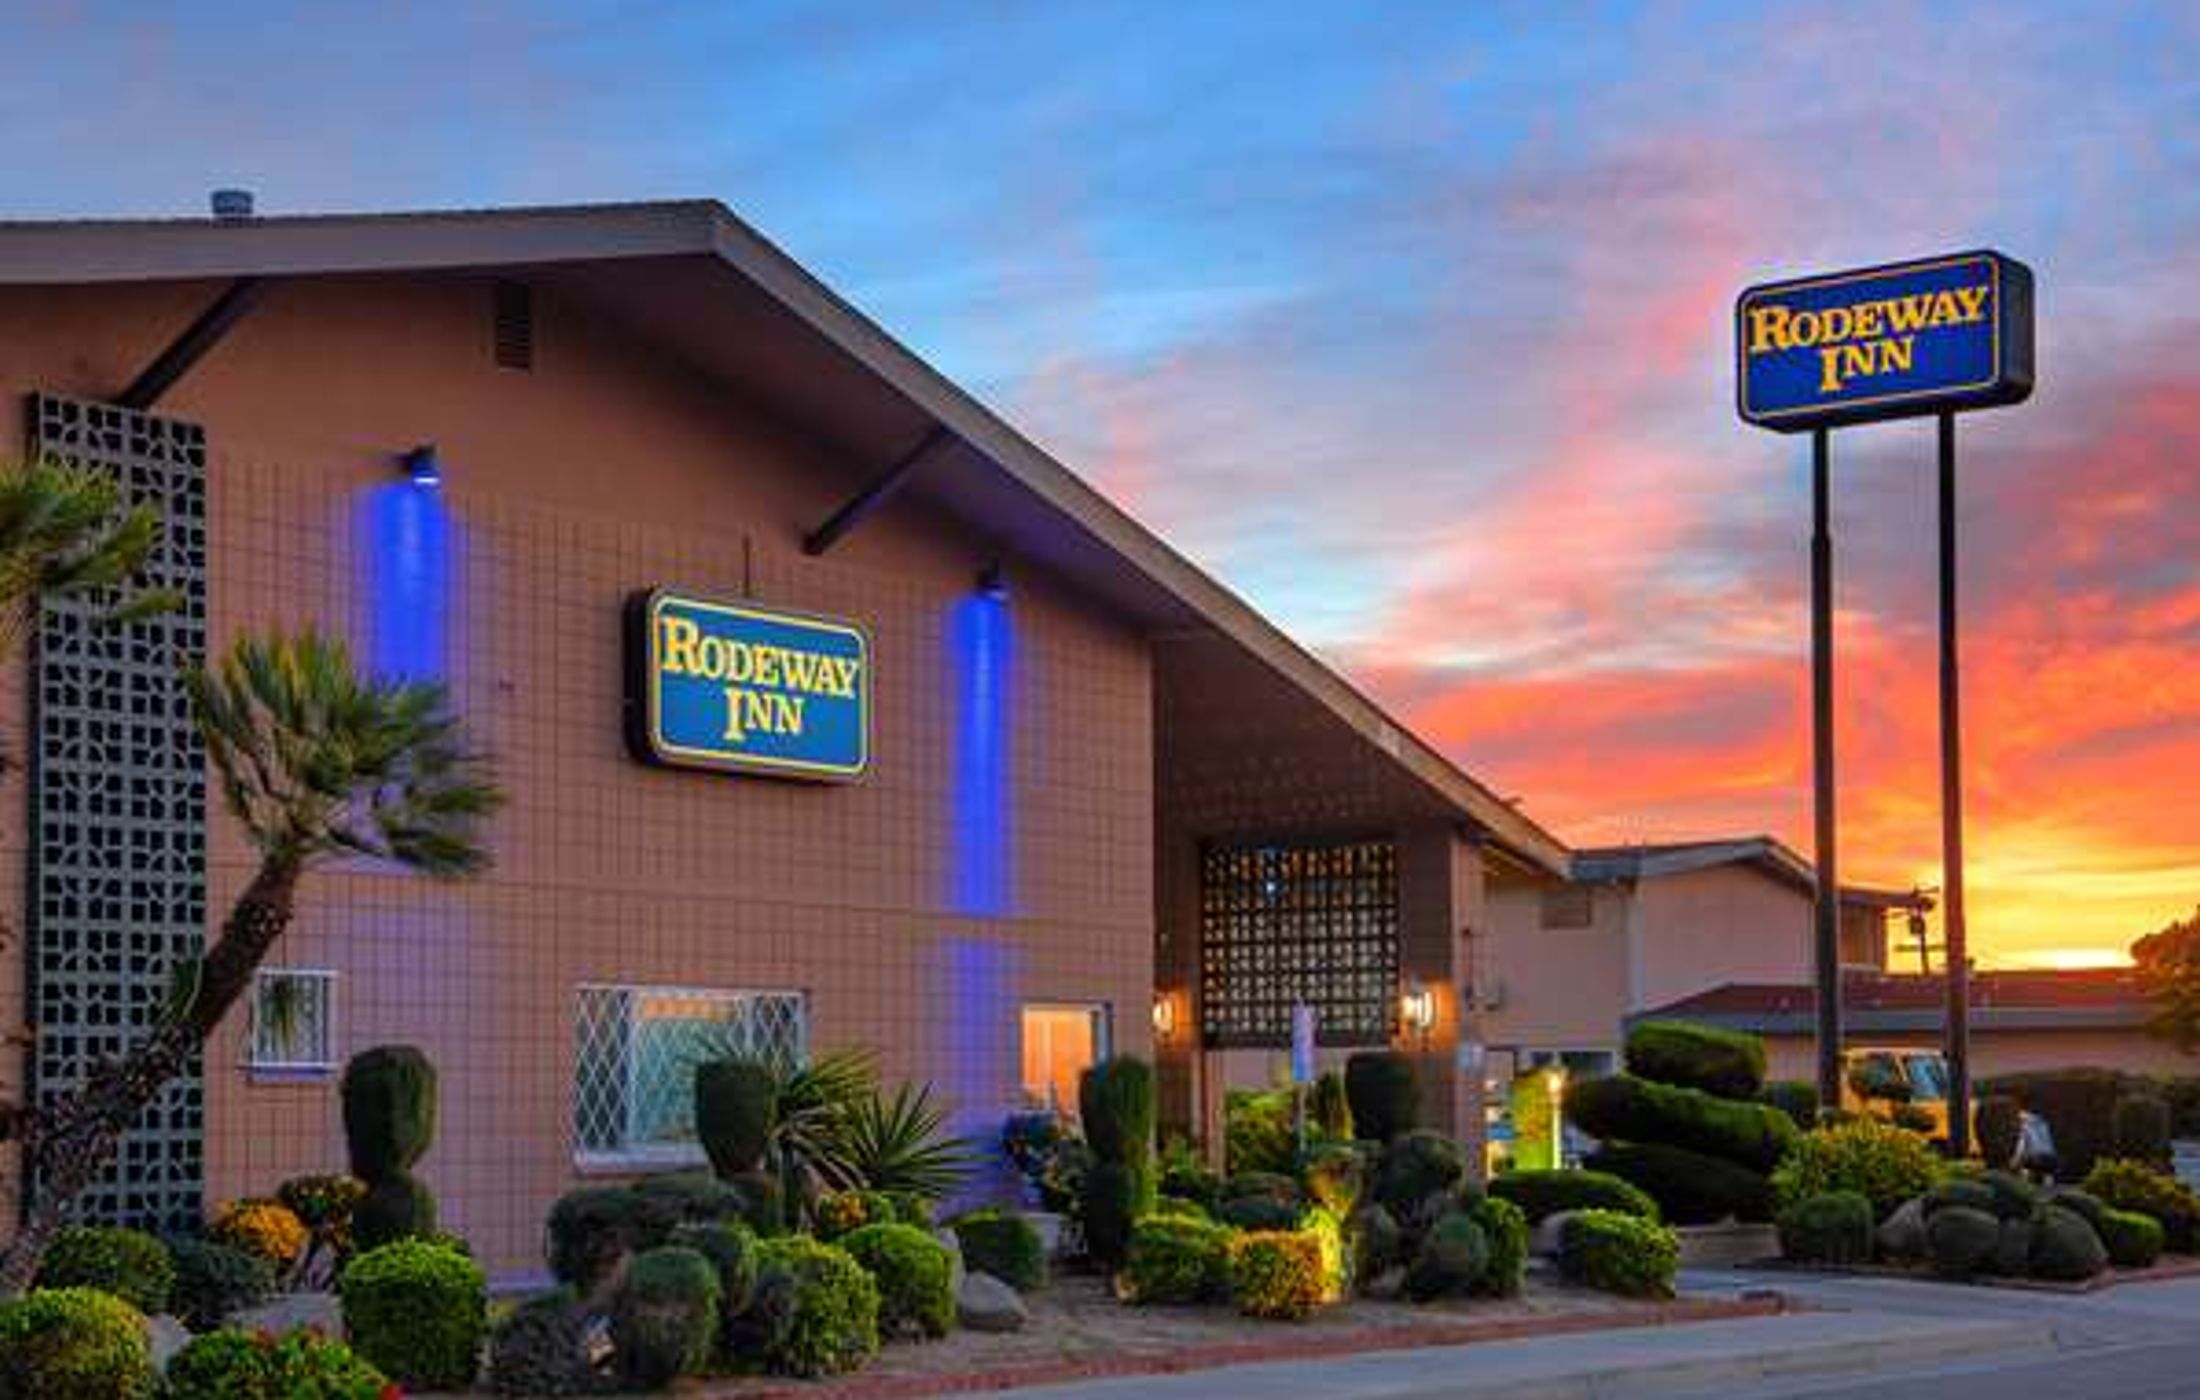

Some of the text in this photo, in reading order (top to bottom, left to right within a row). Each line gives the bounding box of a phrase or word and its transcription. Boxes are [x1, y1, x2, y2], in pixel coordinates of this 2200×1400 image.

[1750, 286, 1988, 353] RODEWAY
[1819, 335, 1915, 393] INN
[661, 615, 860, 699] RODEWAY
[723, 686, 805, 742] INN
